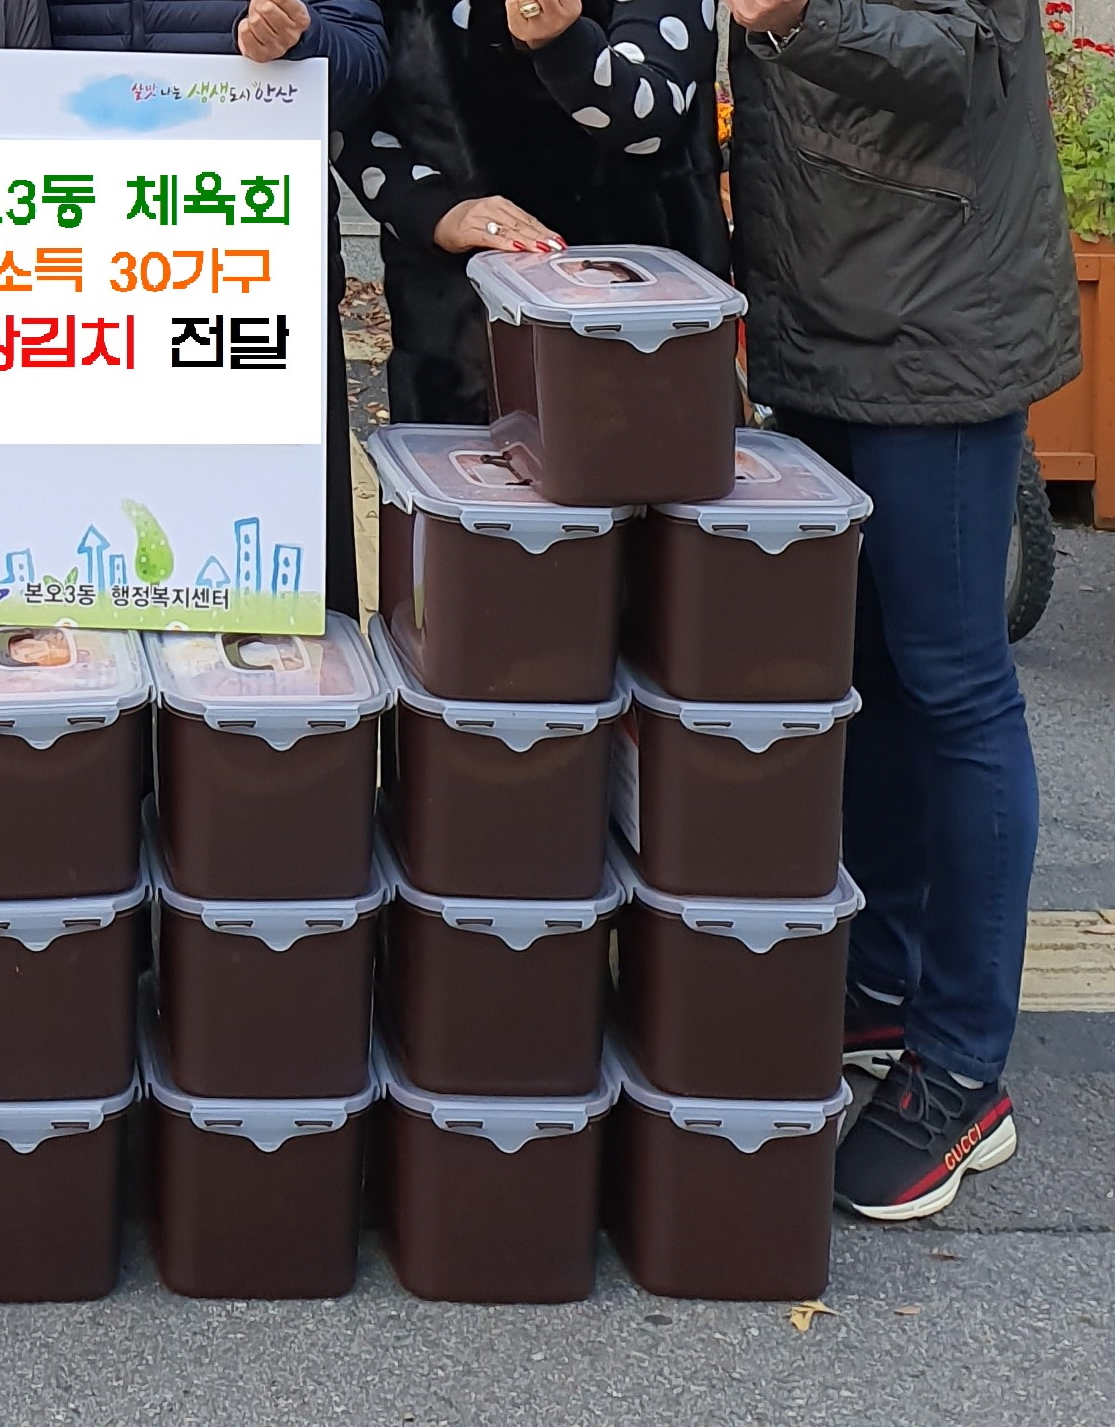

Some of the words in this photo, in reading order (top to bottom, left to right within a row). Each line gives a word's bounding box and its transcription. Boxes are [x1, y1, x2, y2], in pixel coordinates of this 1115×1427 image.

[131, 83, 157, 100] 살맛
[160, 85, 182, 100] 나는
[24, 582, 96, 607] 본오3동
[111, 584, 230, 609] 행정복지센터
[944, 1122, 982, 1171] GUCCI
